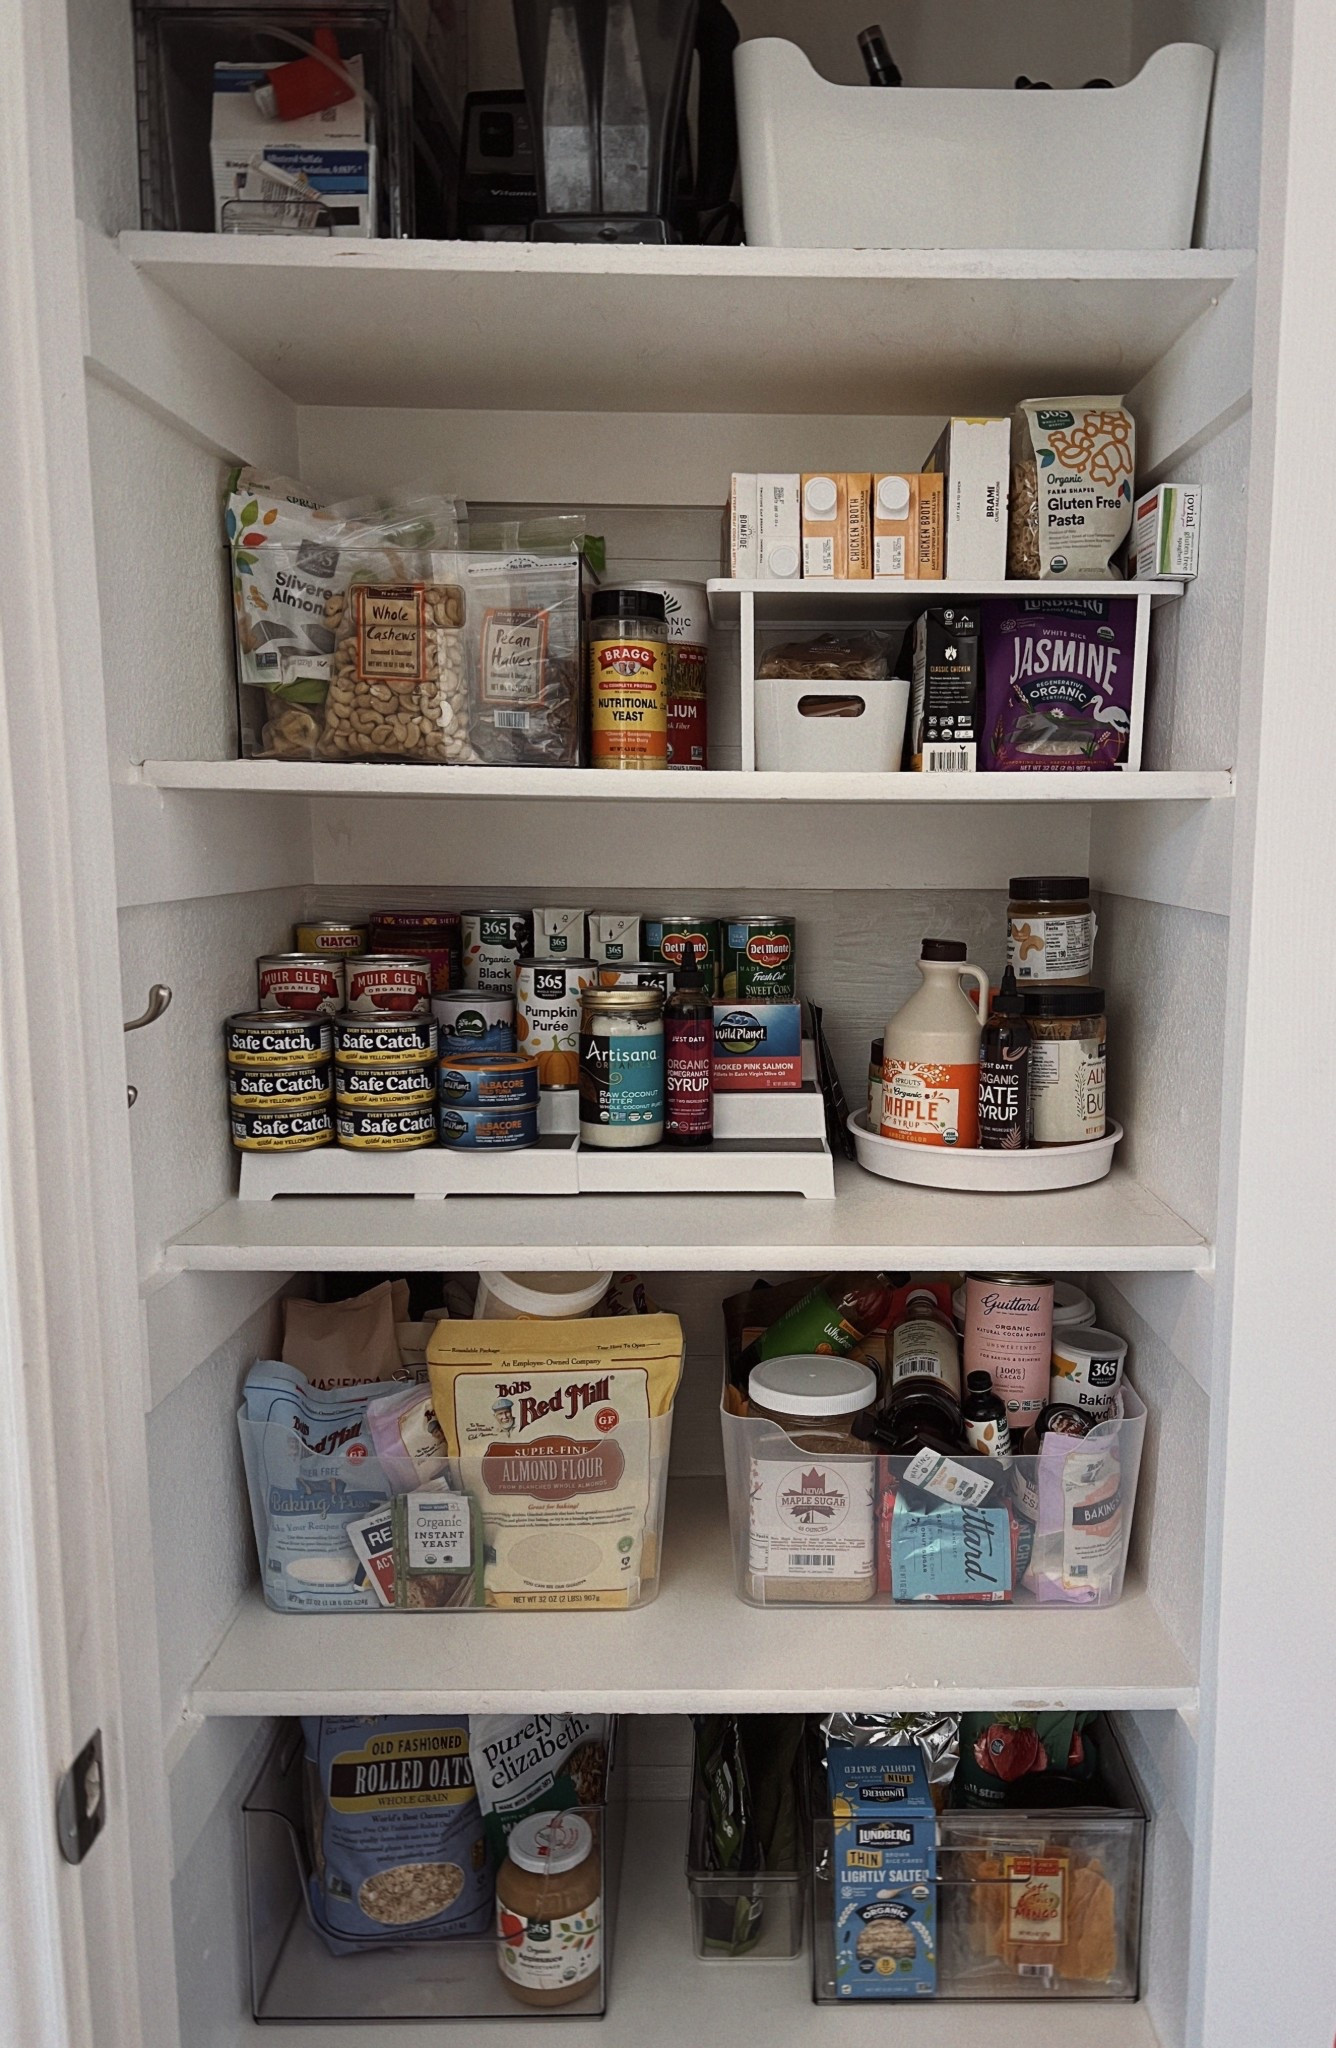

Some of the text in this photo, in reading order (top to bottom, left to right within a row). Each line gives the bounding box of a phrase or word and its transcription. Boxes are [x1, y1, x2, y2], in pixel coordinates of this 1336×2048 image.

[1047, 473, 1083, 485] Organic
[986, 486, 995, 517] BRAMI
[1048, 496, 1122, 511] Gluten Free
[1184, 493, 1197, 528] jovial
[1048, 515, 1085, 527] Pasta
[739, 514, 748, 549] BONAFIDE
[850, 498, 859, 562] CHICKEN BROTH
[921, 500, 930, 563] CHICKEN BROTH
[1183, 532, 1191, 555] gluten
[372, 604, 409, 621] Whole
[366, 626, 417, 642] Cashews
[496, 630, 530, 647] Pecan
[1042, 629, 1068, 637] WHITE
[605, 648, 649, 661] BRAGG
[1009, 636, 1121, 696] JASMINE
[1036, 679, 1085, 690] REGENERATIVE
[1030, 685, 1087, 703] ORGANIC
[599, 698, 657, 708] NUTRITIONAL
[613, 711, 643, 721] YEAST
[482, 921, 507, 935] 365
[321, 937, 359, 947] HATCH
[551, 938, 566, 947] 365
[607, 946, 622, 954] 365
[750, 944, 789, 954] Del Monte
[479, 954, 511, 965] Organic
[264, 971, 328, 985] MUIR GLEN
[358, 971, 423, 987] MUIR GLEN
[479, 968, 512, 979] Black
[477, 981, 513, 992] Beans
[536, 974, 563, 990] 365
[745, 984, 792, 995] SWEET CORN
[525, 1004, 578, 1018] Pumpkin
[532, 1018, 569, 1031] Purée
[715, 1028, 764, 1040] Wild Planet
[232, 1034, 315, 1050] Safe Catch
[343, 1033, 425, 1049] Safe Catch
[585, 1040, 657, 1061] Artisana
[667, 1059, 709, 1070] ORGANIC
[714, 1063, 742, 1071] MOKED
[762, 1062, 793, 1070] SALMON
[240, 1075, 325, 1092] Safe Catch
[350, 1074, 432, 1092] Safe Catch
[667, 1078, 709, 1092] SYRUP
[600, 1089, 659, 1098] RAW COCONUT
[893, 1086, 922, 1098] Organic
[884, 1095, 939, 1121] MAPLE
[252, 1115, 332, 1135] Safe Catch
[361, 1115, 436, 1133] Safe Catch
[893, 1118, 920, 1129] SYRUP
[284, 1137, 315, 1145] YELLOWFIN
[981, 1293, 1041, 1316] Guittard
[995, 1324, 1031, 1332] ORGANIC
[1092, 1362, 1116, 1377] 365
[494, 1375, 611, 1433] Bob's Red Mill
[598, 1416, 616, 1425] GF
[514, 1446, 589, 1457] SUPER-FINE
[502, 1457, 603, 1482] ALMOND FLOUR
[802, 1487, 825, 1495] NOVA
[556, 1503, 580, 1511] baking!
[781, 1496, 846, 1507] MAPLE SUGAR
[416, 1514, 462, 1529] Organic
[415, 1531, 465, 1539] INSTANT
[559, 1595, 566, 1603] (2
[567, 1595, 582, 1603] LBS)
[372, 1735, 462, 1756] OLD FASHIONED
[482, 1714, 553, 1770] purely
[491, 1717, 590, 1789] elizabeth.
[355, 1757, 474, 1795] ROLLED OATS
[844, 1765, 916, 1774] LIGHTLY SALTED
[888, 1774, 912, 1783] THIN
[862, 1787, 905, 1797] LUNDBERG
[378, 1793, 449, 1806] WHOLE GRAIN
[859, 1829, 911, 1844] LUNDBERG
[849, 1851, 879, 1866] THIN
[841, 1869, 930, 1883] LIGHTLY SALTED
[862, 1907, 909, 1919] ORGANIC
[527, 1946, 551, 1954] Organic
[518, 1952, 563, 1963] Applesauce
